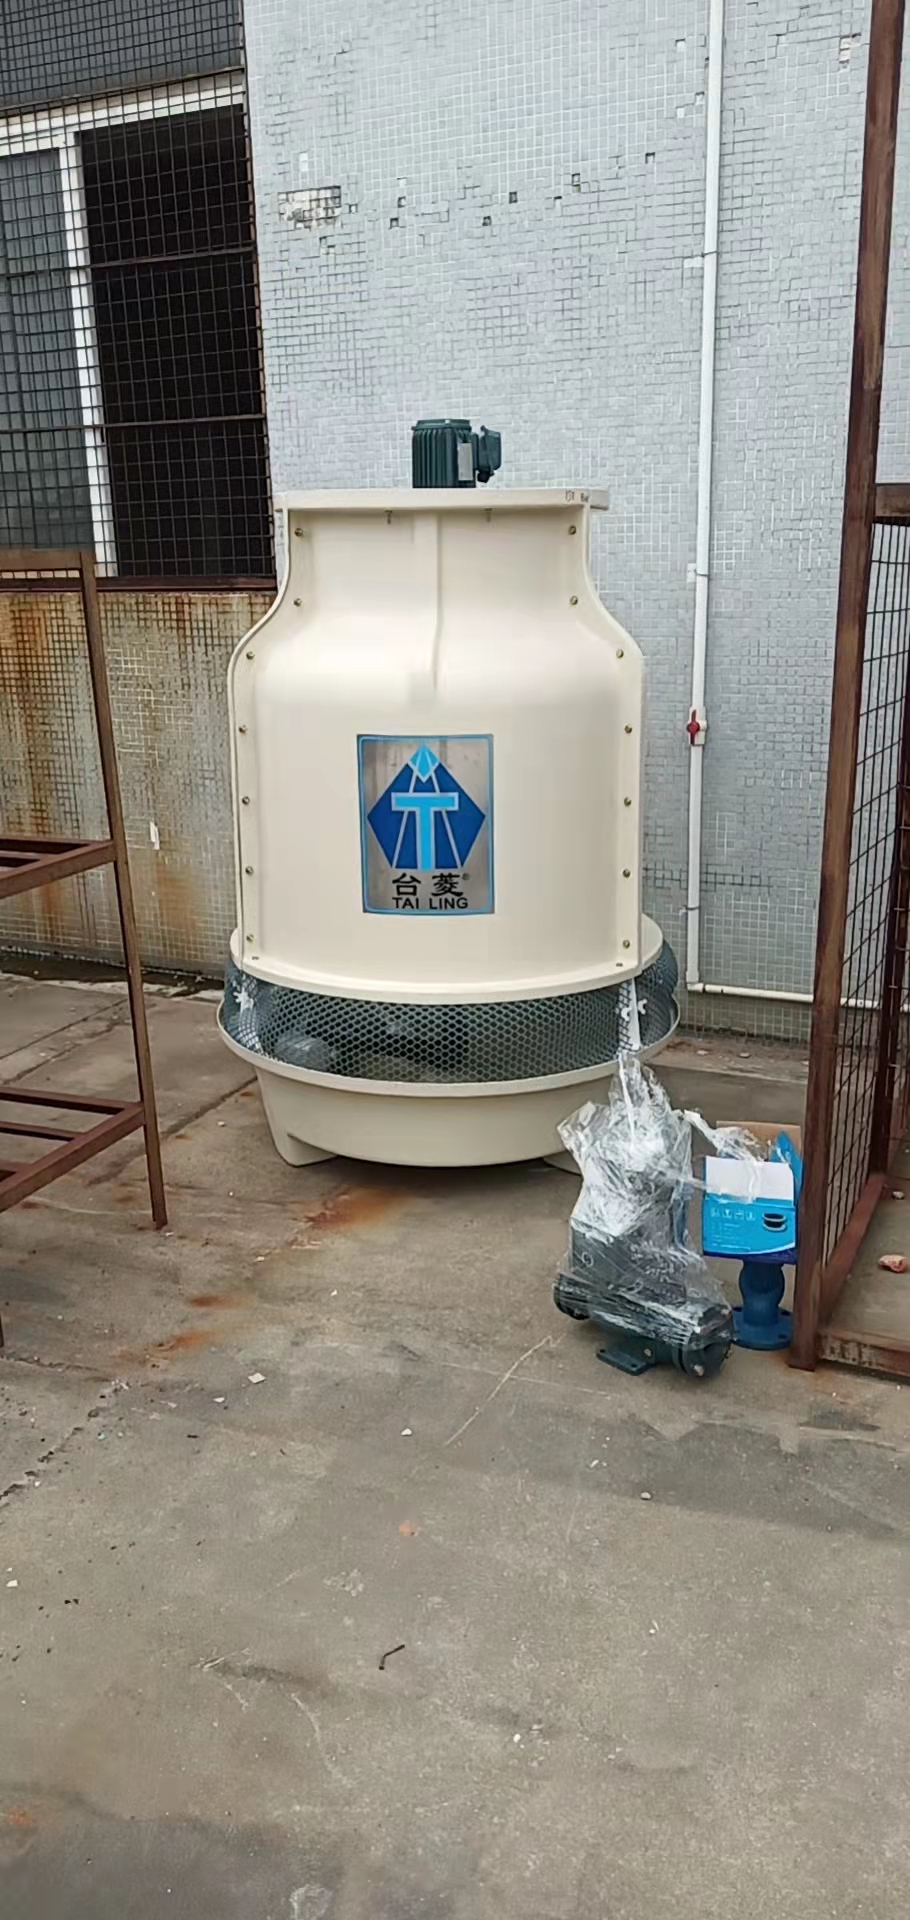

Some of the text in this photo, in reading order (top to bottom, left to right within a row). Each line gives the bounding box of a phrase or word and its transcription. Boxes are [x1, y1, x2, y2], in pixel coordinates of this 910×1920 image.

[392, 873, 464, 897] 台菱
[392, 897, 468, 910] TAI LING
